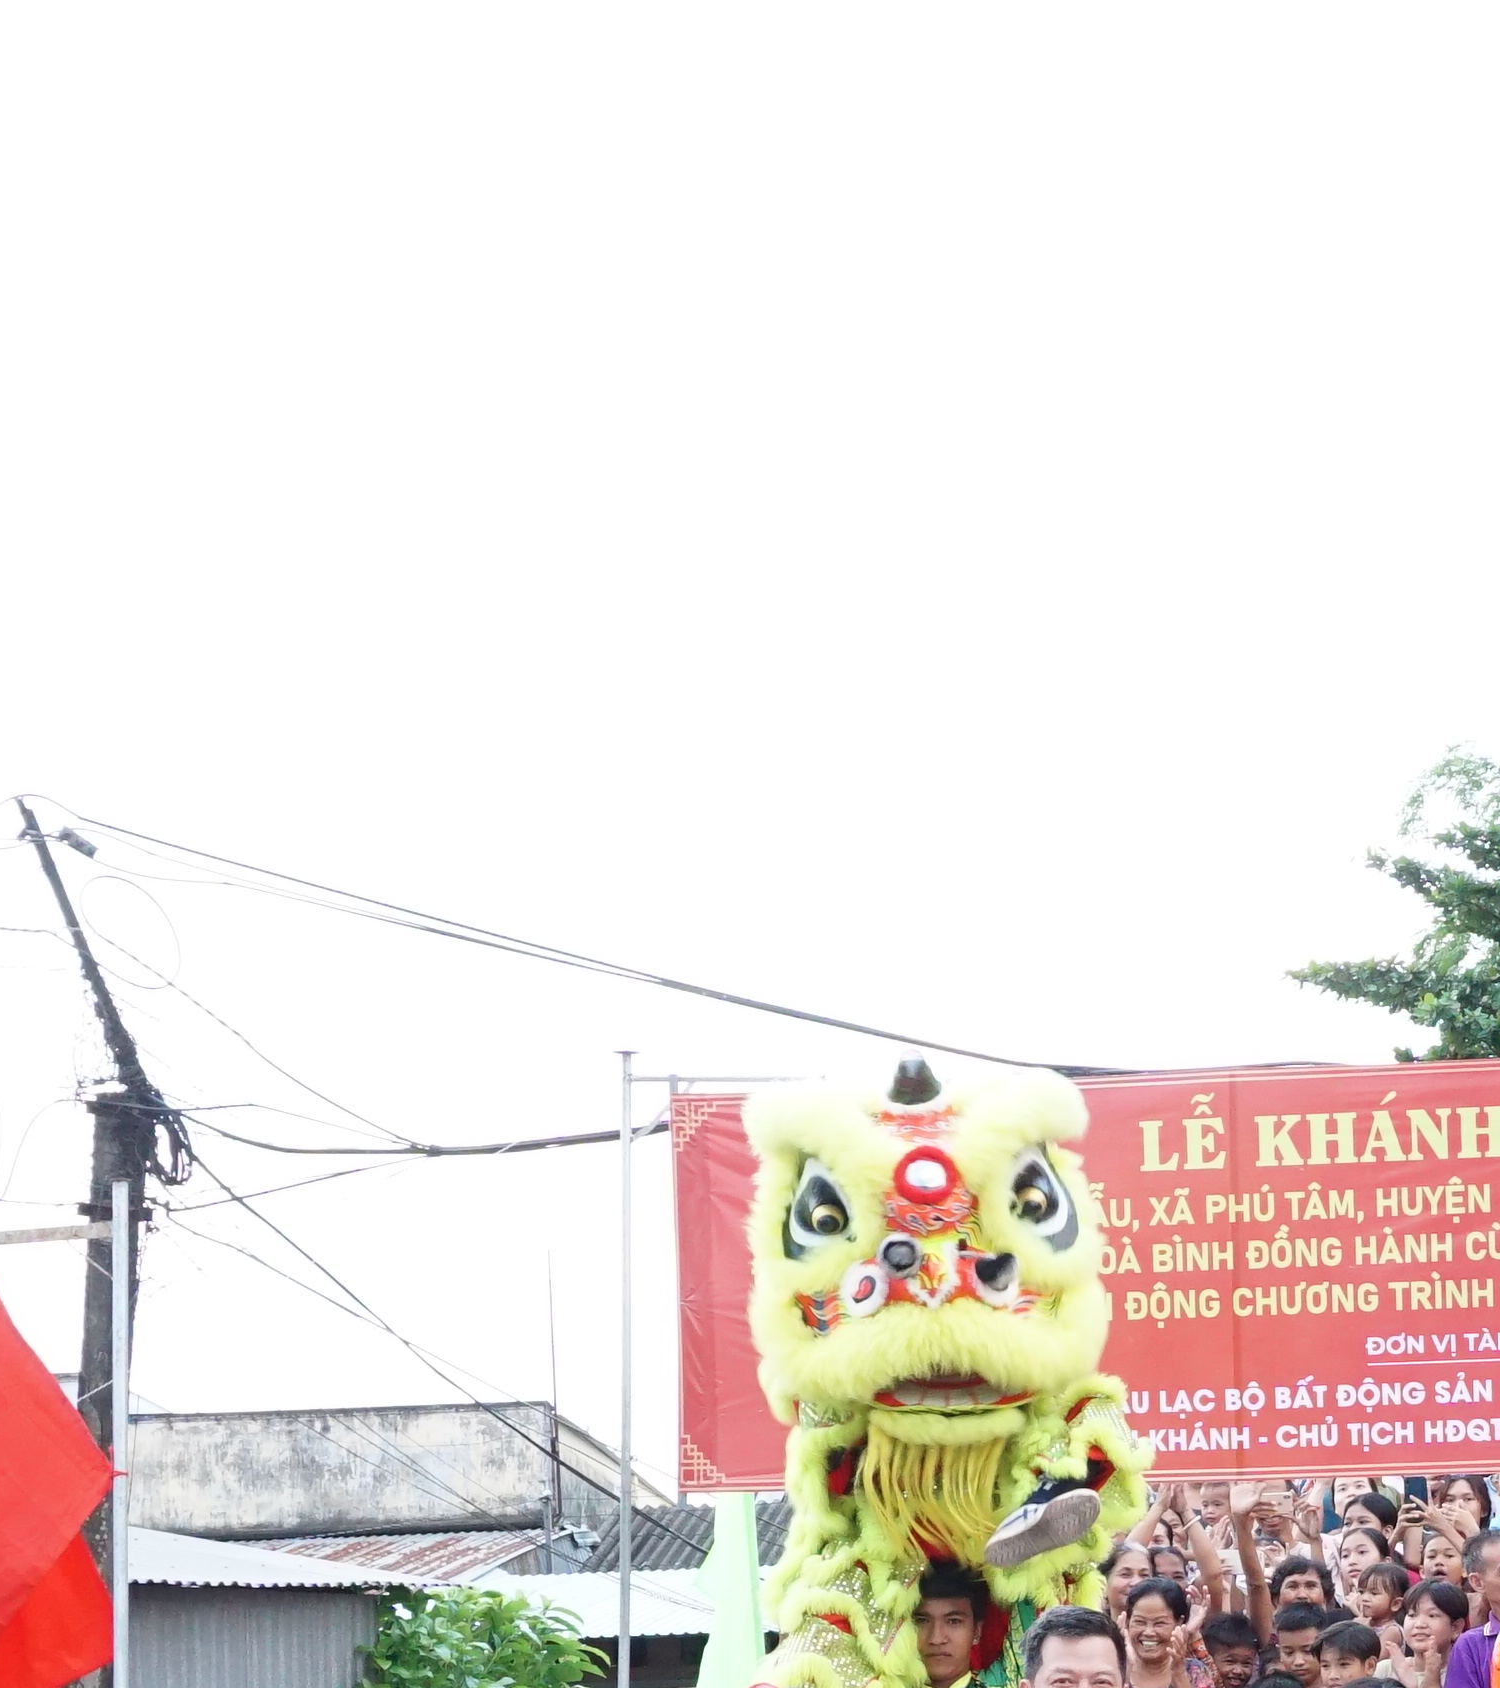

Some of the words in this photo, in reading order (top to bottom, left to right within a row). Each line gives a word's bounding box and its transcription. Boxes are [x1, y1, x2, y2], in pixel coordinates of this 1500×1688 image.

[1138, 1091, 1227, 1172] LỄ
[1089, 1182, 1140, 1233] ẪU,
[1148, 1187, 1195, 1226] XÃ
[1205, 1183, 1275, 1224] PHÚ
[1284, 1181, 1365, 1225] TÂM,
[1375, 1175, 1491, 1224] HUYỆN
[1099, 1235, 1142, 1275] OÀ
[1151, 1233, 1234, 1273] BÌNH
[1245, 1224, 1343, 1270] ĐỒNG
[1354, 1226, 1453, 1266] HÀNH
[1124, 1281, 1221, 1329] ĐỘNG
[1232, 1281, 1379, 1317] CHƯƠNG
[1387, 1270, 1495, 1312] TRÌNH
[1364, 1331, 1425, 1356] ĐƠN
[1430, 1333, 1457, 1358] VỊ
[1158, 1388, 1216, 1419] LẠC
[1224, 1380, 1266, 1417] BỘ
[1274, 1374, 1328, 1410] BẤT
[1335, 1376, 1426, 1413] ĐỘNG
[1434, 1371, 1493, 1404] SẢN
[1149, 1420, 1250, 1452] KHÁNH
[1275, 1415, 1338, 1449] CHỦ
[1347, 1420, 1415, 1452] TỊCH
